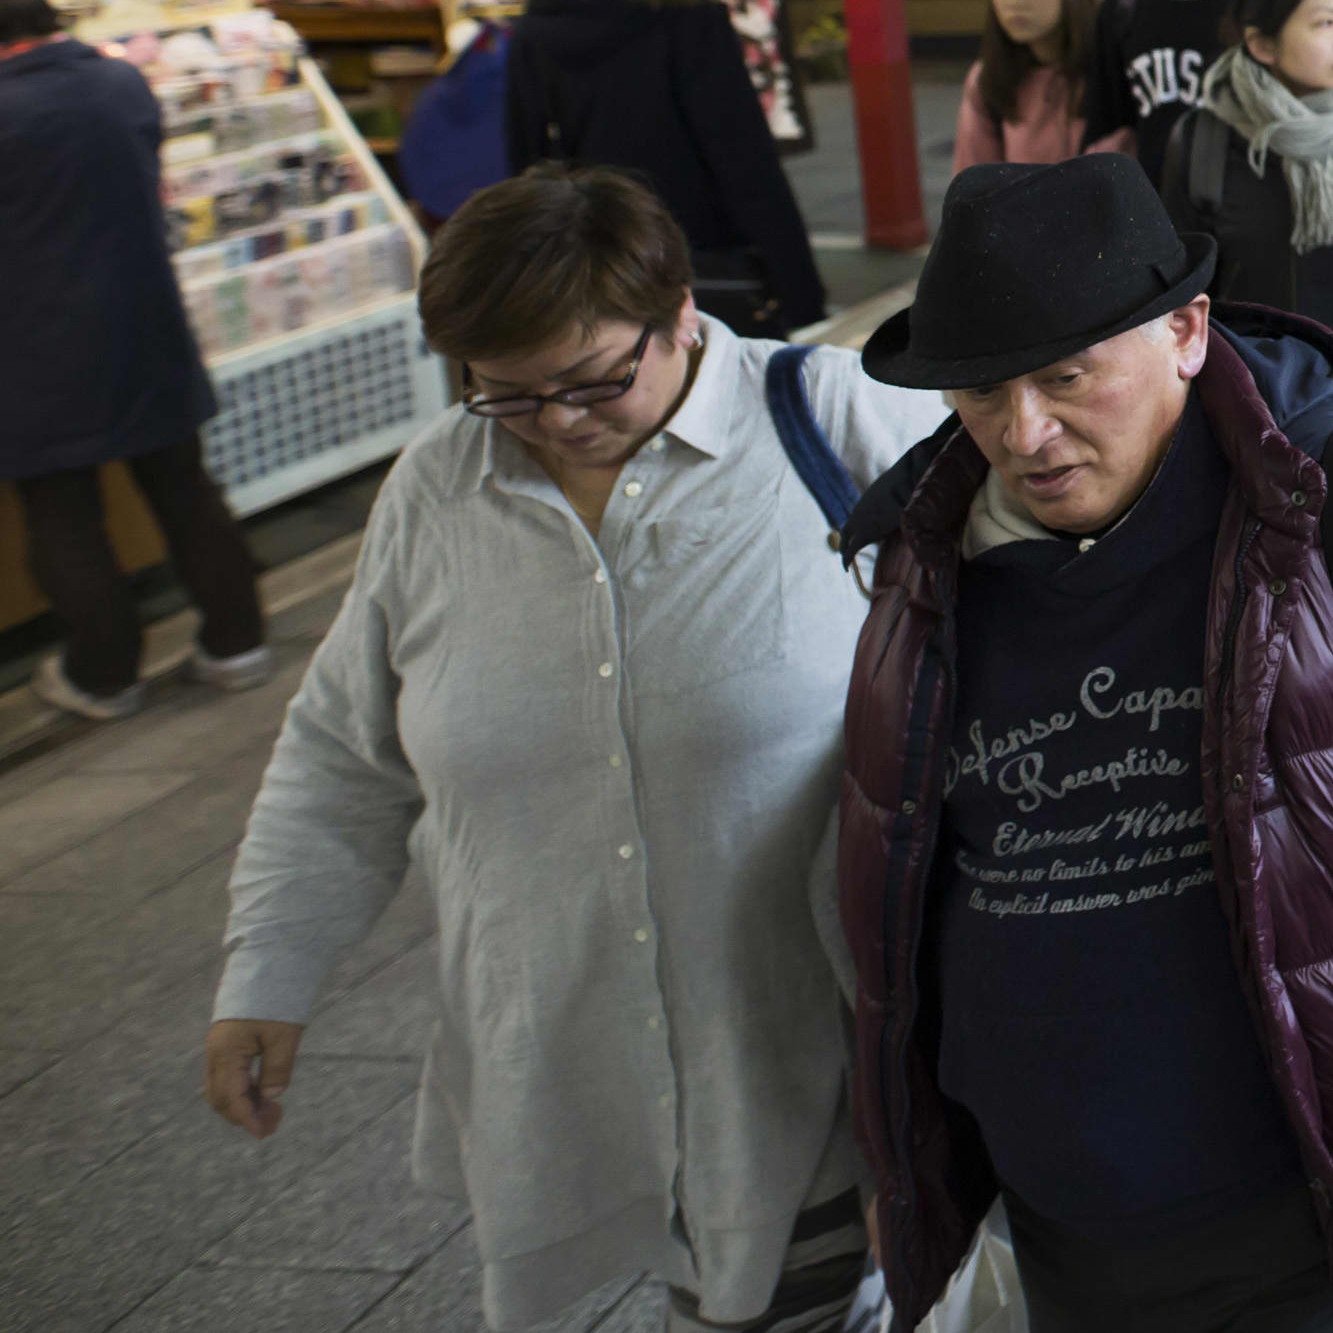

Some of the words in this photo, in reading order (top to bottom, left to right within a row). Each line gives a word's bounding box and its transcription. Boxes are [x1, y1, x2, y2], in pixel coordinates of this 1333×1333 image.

[997, 747, 1189, 813] Receptive
[992, 813, 1113, 857] Eternal
[1048, 857, 1110, 881] limits
[1114, 853, 1137, 873] to
[1139, 843, 1176, 868] his
[988, 890, 1049, 920] explicit
[1050, 890, 1124, 914] answer
[1126, 877, 1173, 904] was
